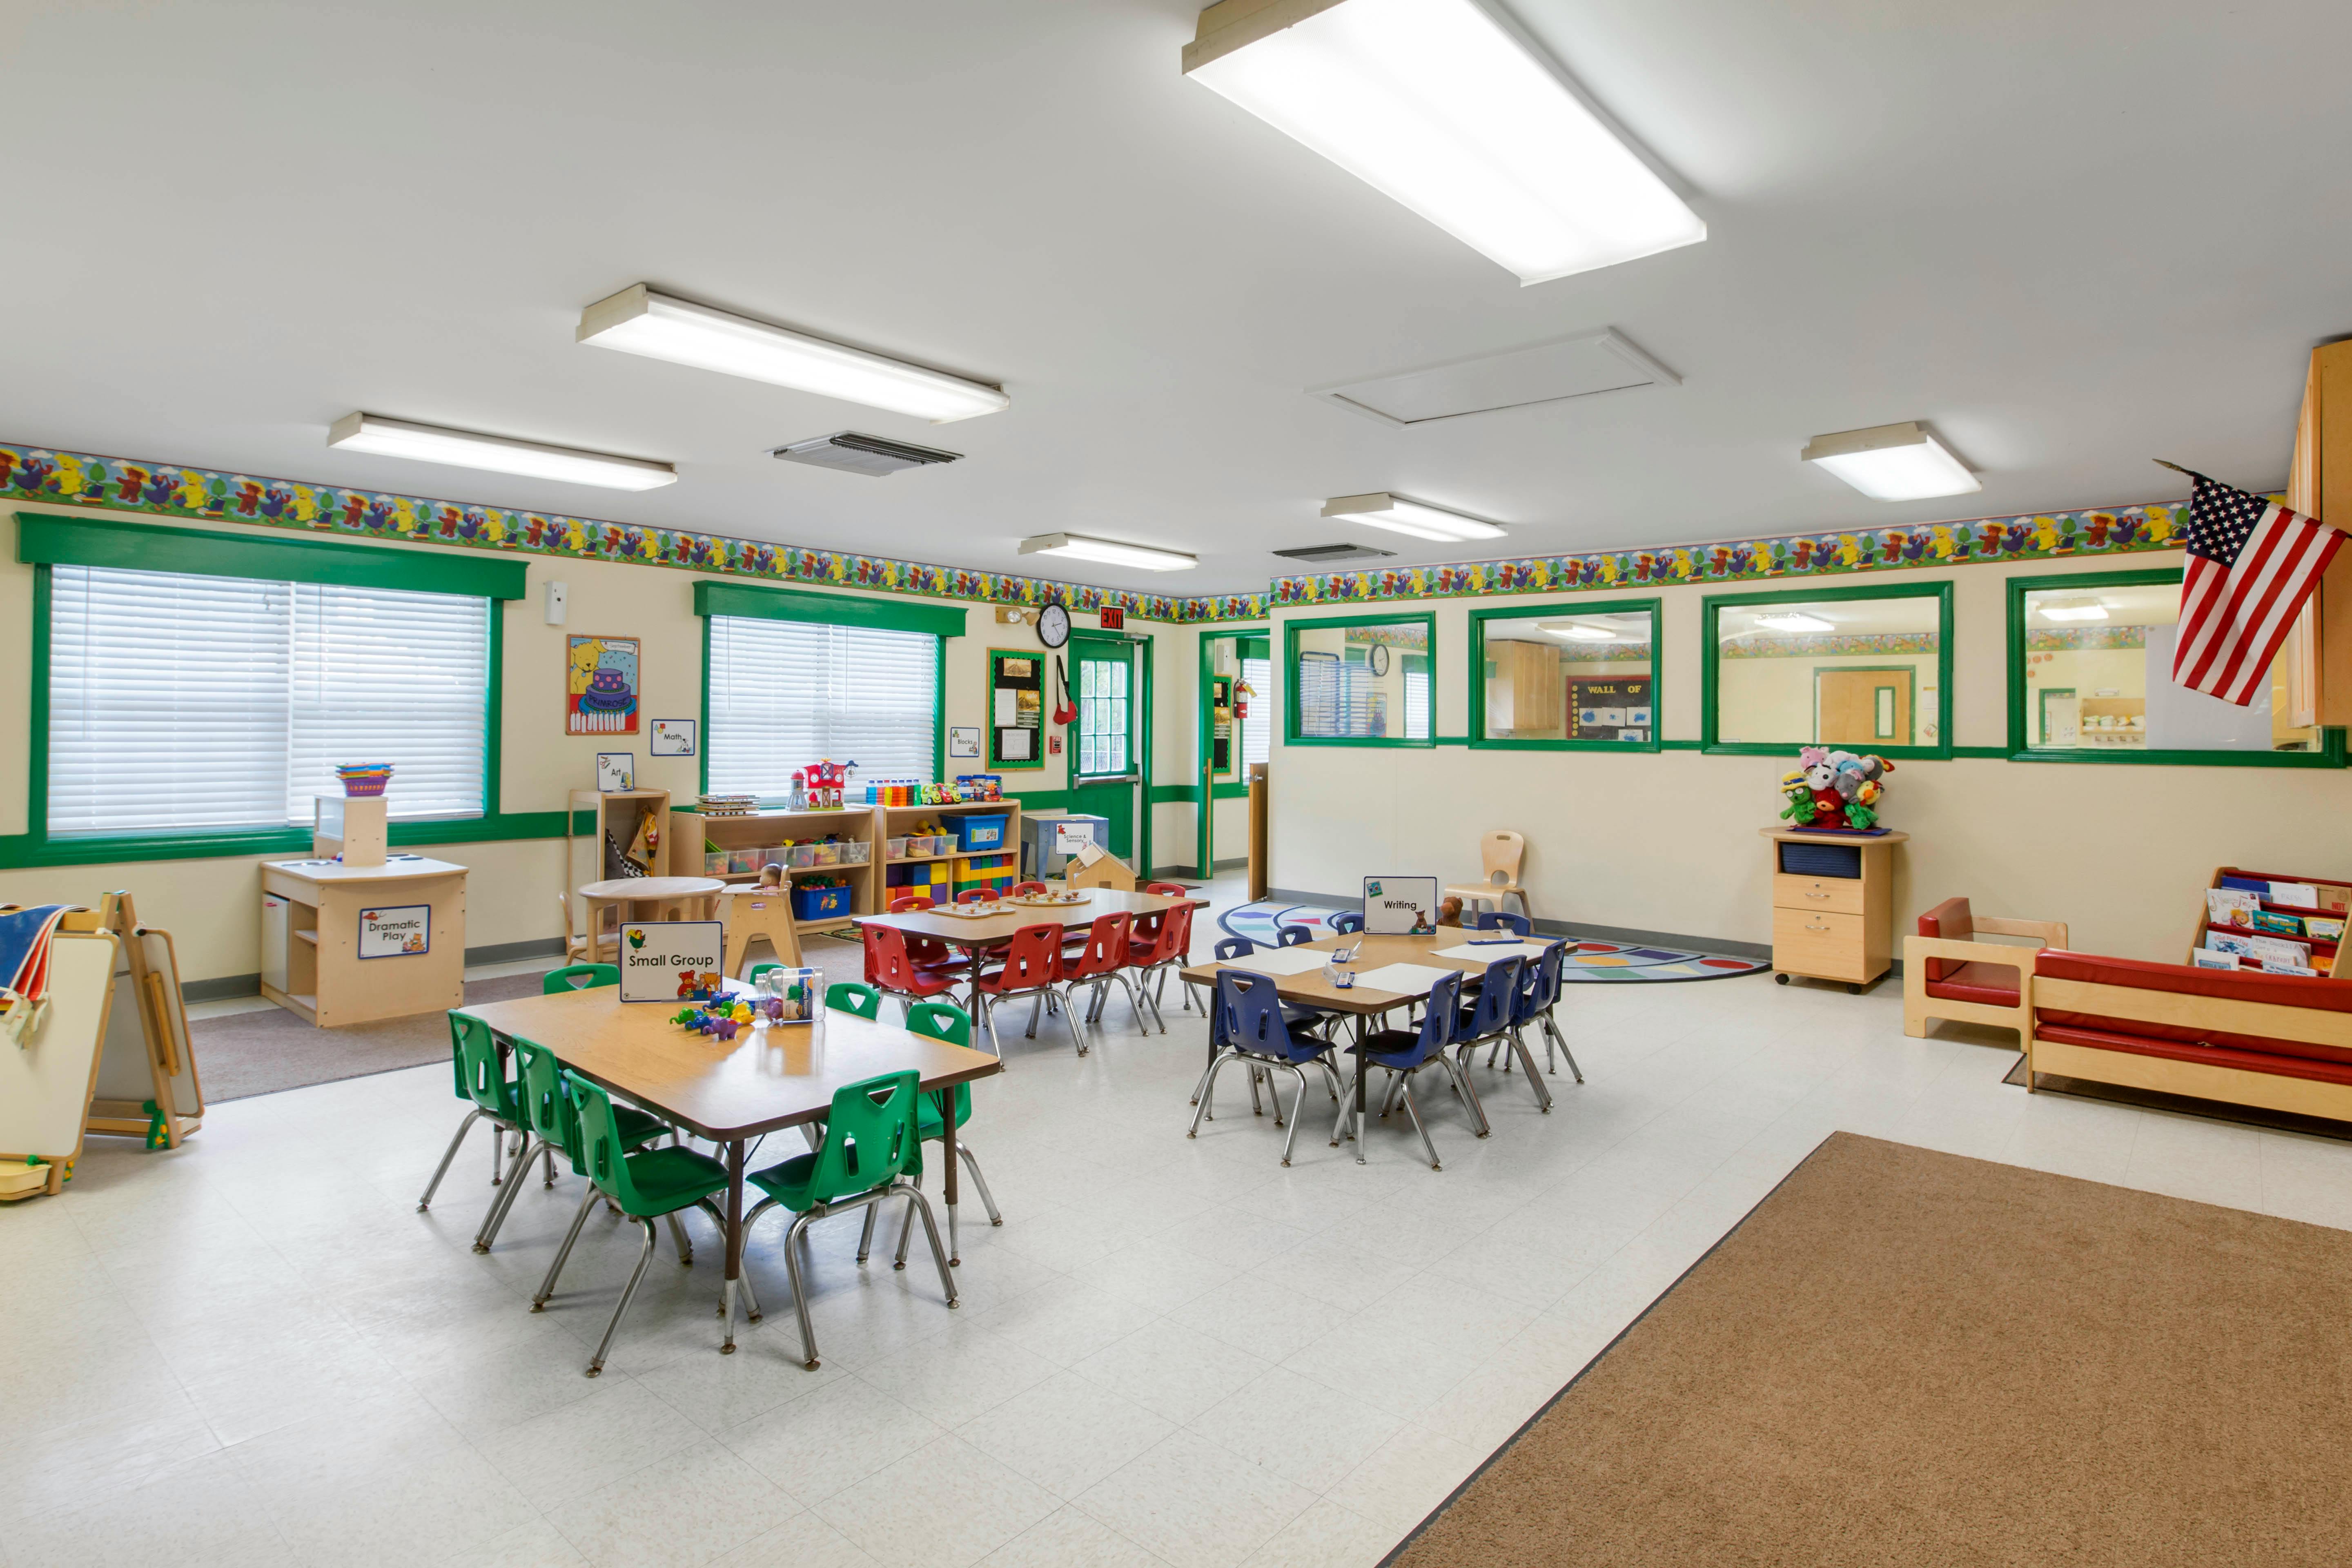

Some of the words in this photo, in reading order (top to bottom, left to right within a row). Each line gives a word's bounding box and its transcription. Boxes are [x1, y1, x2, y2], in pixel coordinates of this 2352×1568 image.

[1102, 607, 1123, 628] EXIT
[1588, 686, 1616, 694] WALL
[1628, 685, 1642, 693] OF
[589, 695, 628, 707] PRIMROSE
[1384, 901, 1417, 911] Writing
[2332, 902, 2346, 911] NOT
[369, 920, 420, 931] Dramatic
[383, 932, 406, 941] Play
[629, 955, 666, 967] Small
[670, 955, 713, 968] Group
